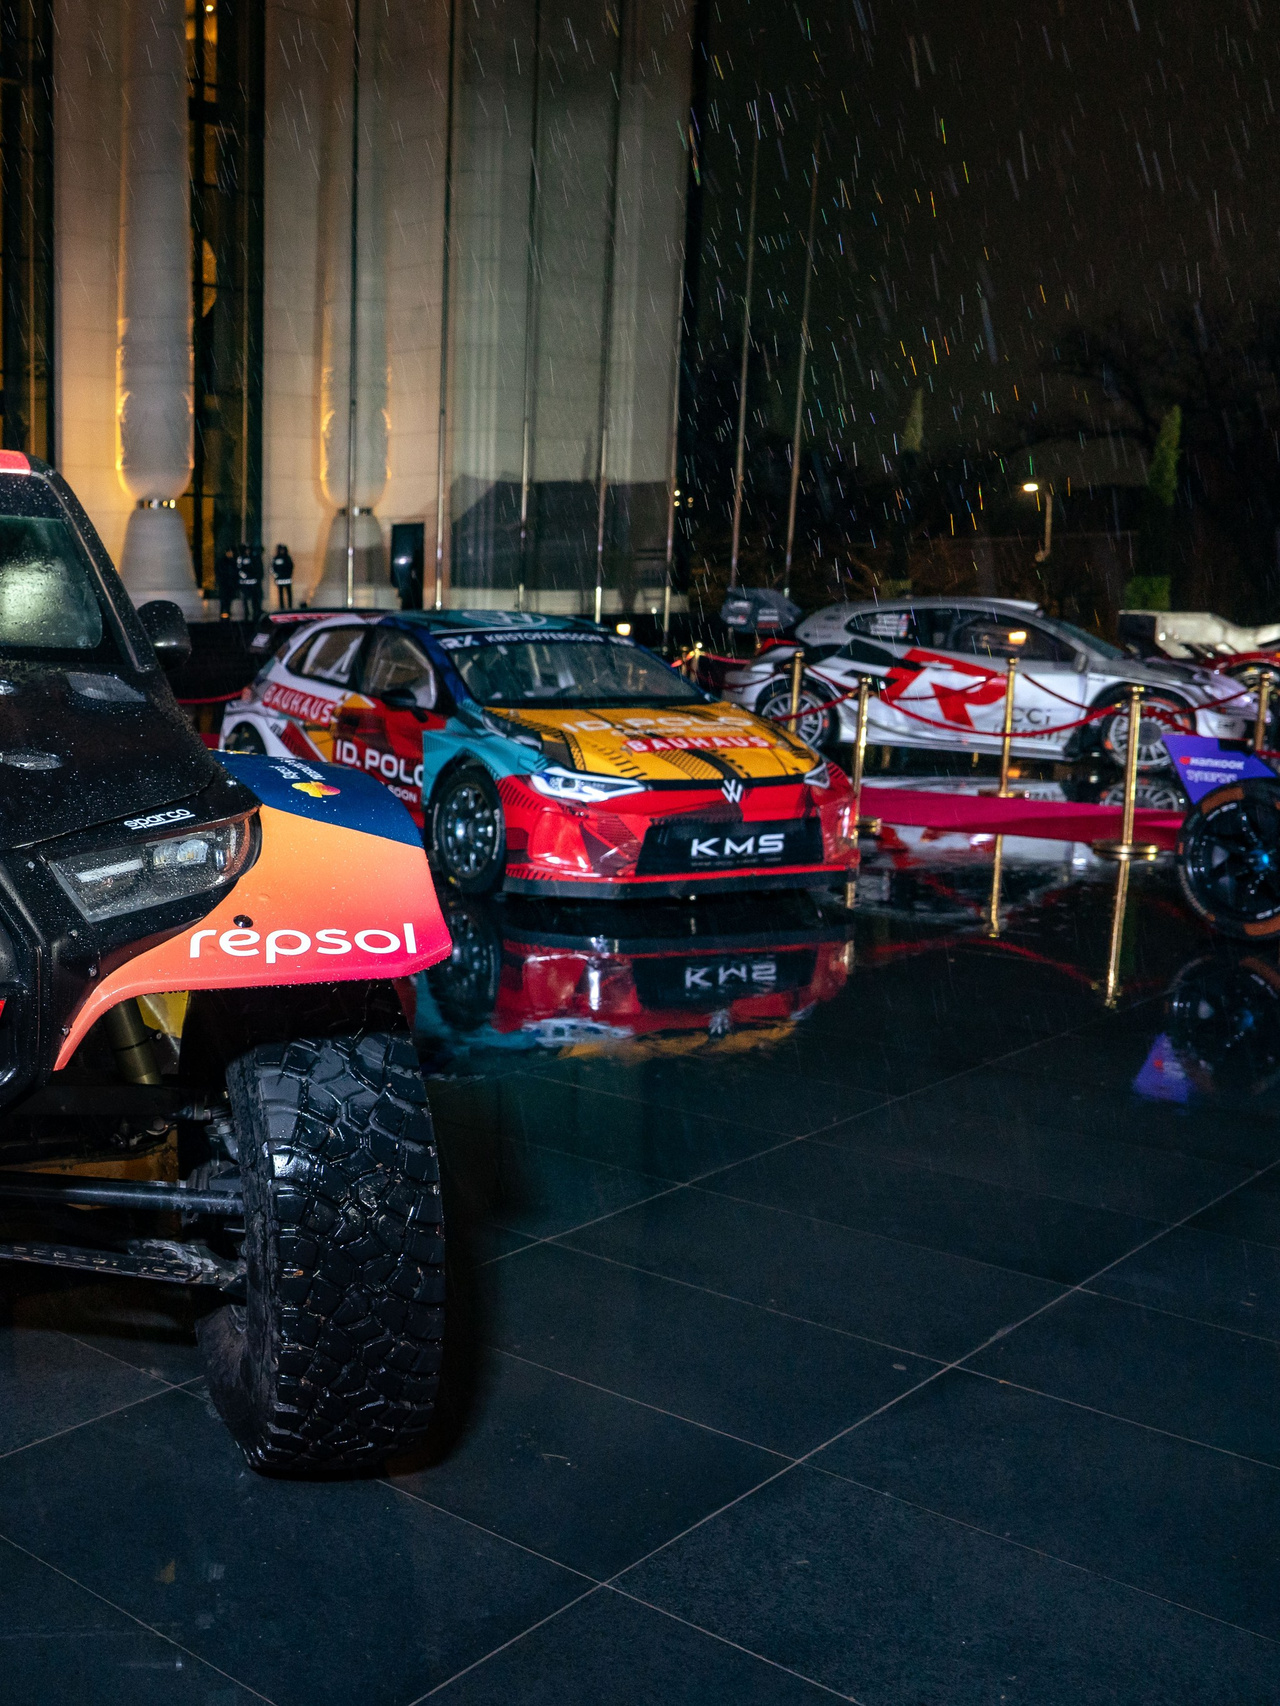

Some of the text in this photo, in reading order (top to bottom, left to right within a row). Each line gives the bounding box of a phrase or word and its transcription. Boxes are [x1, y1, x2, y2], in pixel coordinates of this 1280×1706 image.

[263, 684, 335, 724] BAUHAUS
[336, 739, 361, 767] ID.
[625, 736, 769, 752] BAUHAUS
[124, 808, 193, 829] sparco
[691, 833, 785, 856] KMS
[190, 923, 417, 964] repsol
